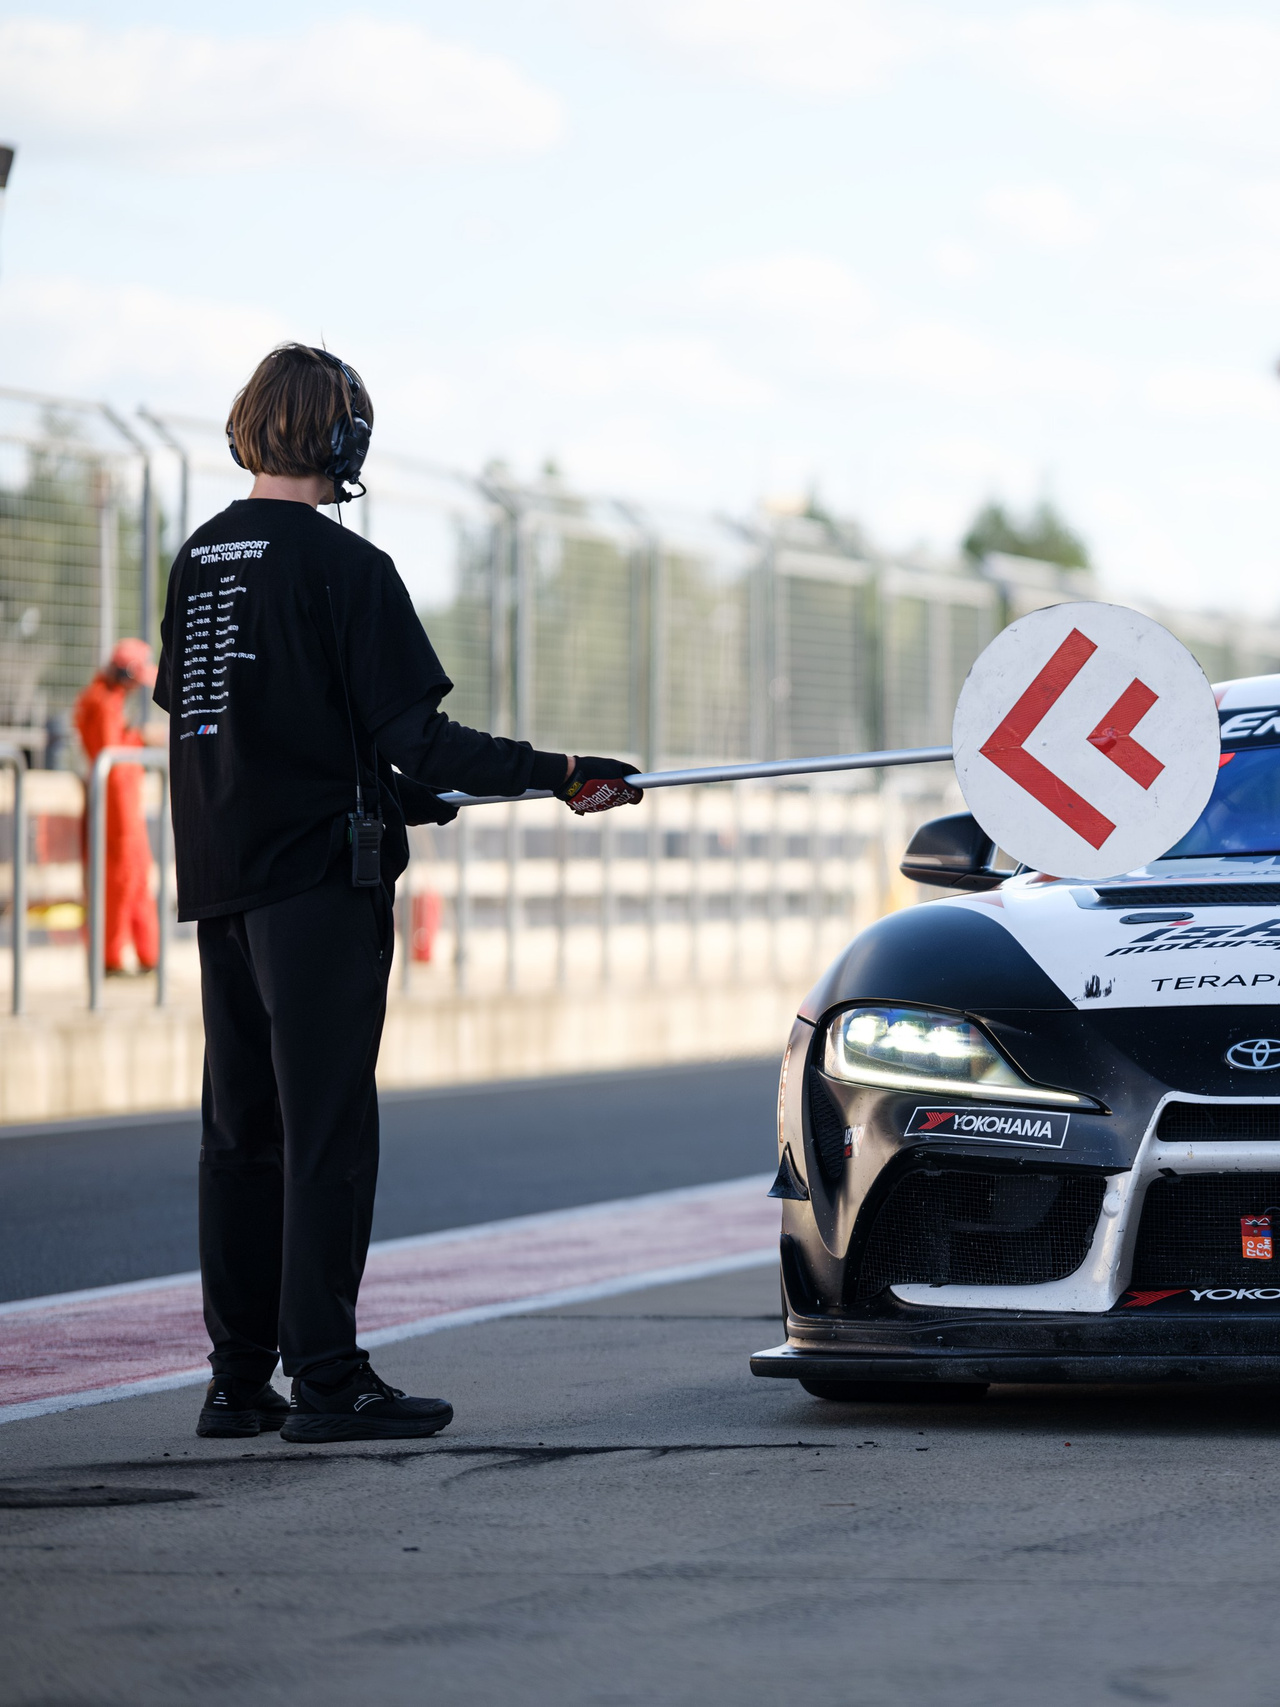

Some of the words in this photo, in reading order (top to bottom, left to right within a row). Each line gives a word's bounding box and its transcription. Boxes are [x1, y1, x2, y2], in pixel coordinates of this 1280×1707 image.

[190, 545, 211, 558] BMW
[211, 540, 270, 554] MOTORSPORT
[200, 550, 242, 565] DTM-TOUR
[242, 549, 264, 559] 2015
[953, 1114, 1052, 1139] YOKOHAMA
